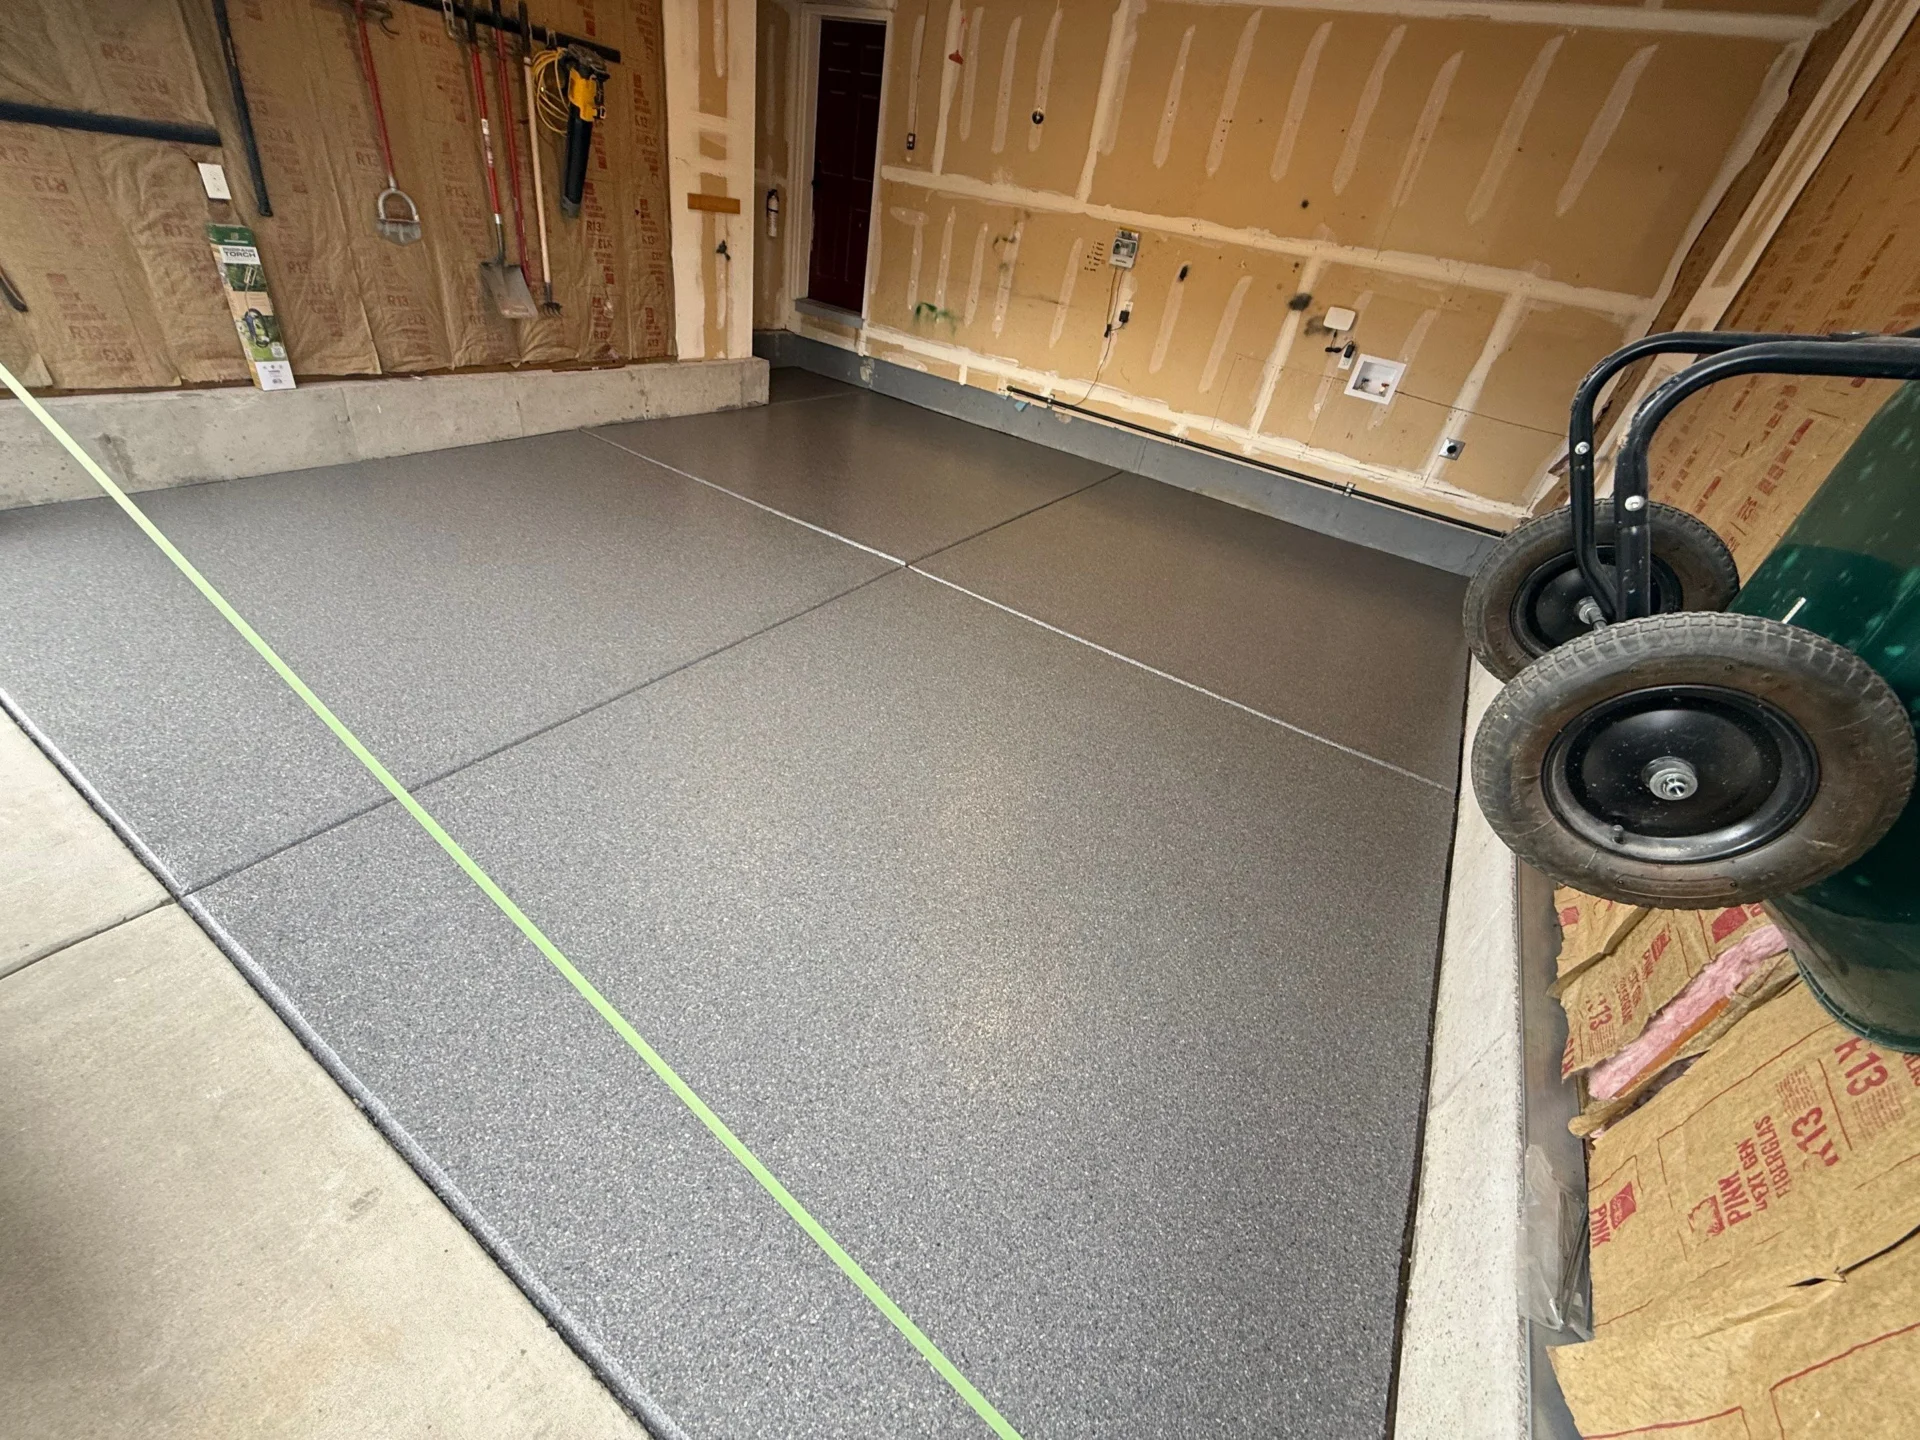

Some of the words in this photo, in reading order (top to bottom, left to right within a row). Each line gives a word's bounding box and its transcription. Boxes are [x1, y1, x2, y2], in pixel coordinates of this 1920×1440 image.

[586, 220, 602, 233] R13
[388, 294, 410, 308] R13
[1736, 1137, 1759, 1171] GEN
[1754, 1114, 1792, 1200] FIBERGLAS
[1717, 1169, 1753, 1227] PINK
[1589, 1202, 1612, 1249] PINK
